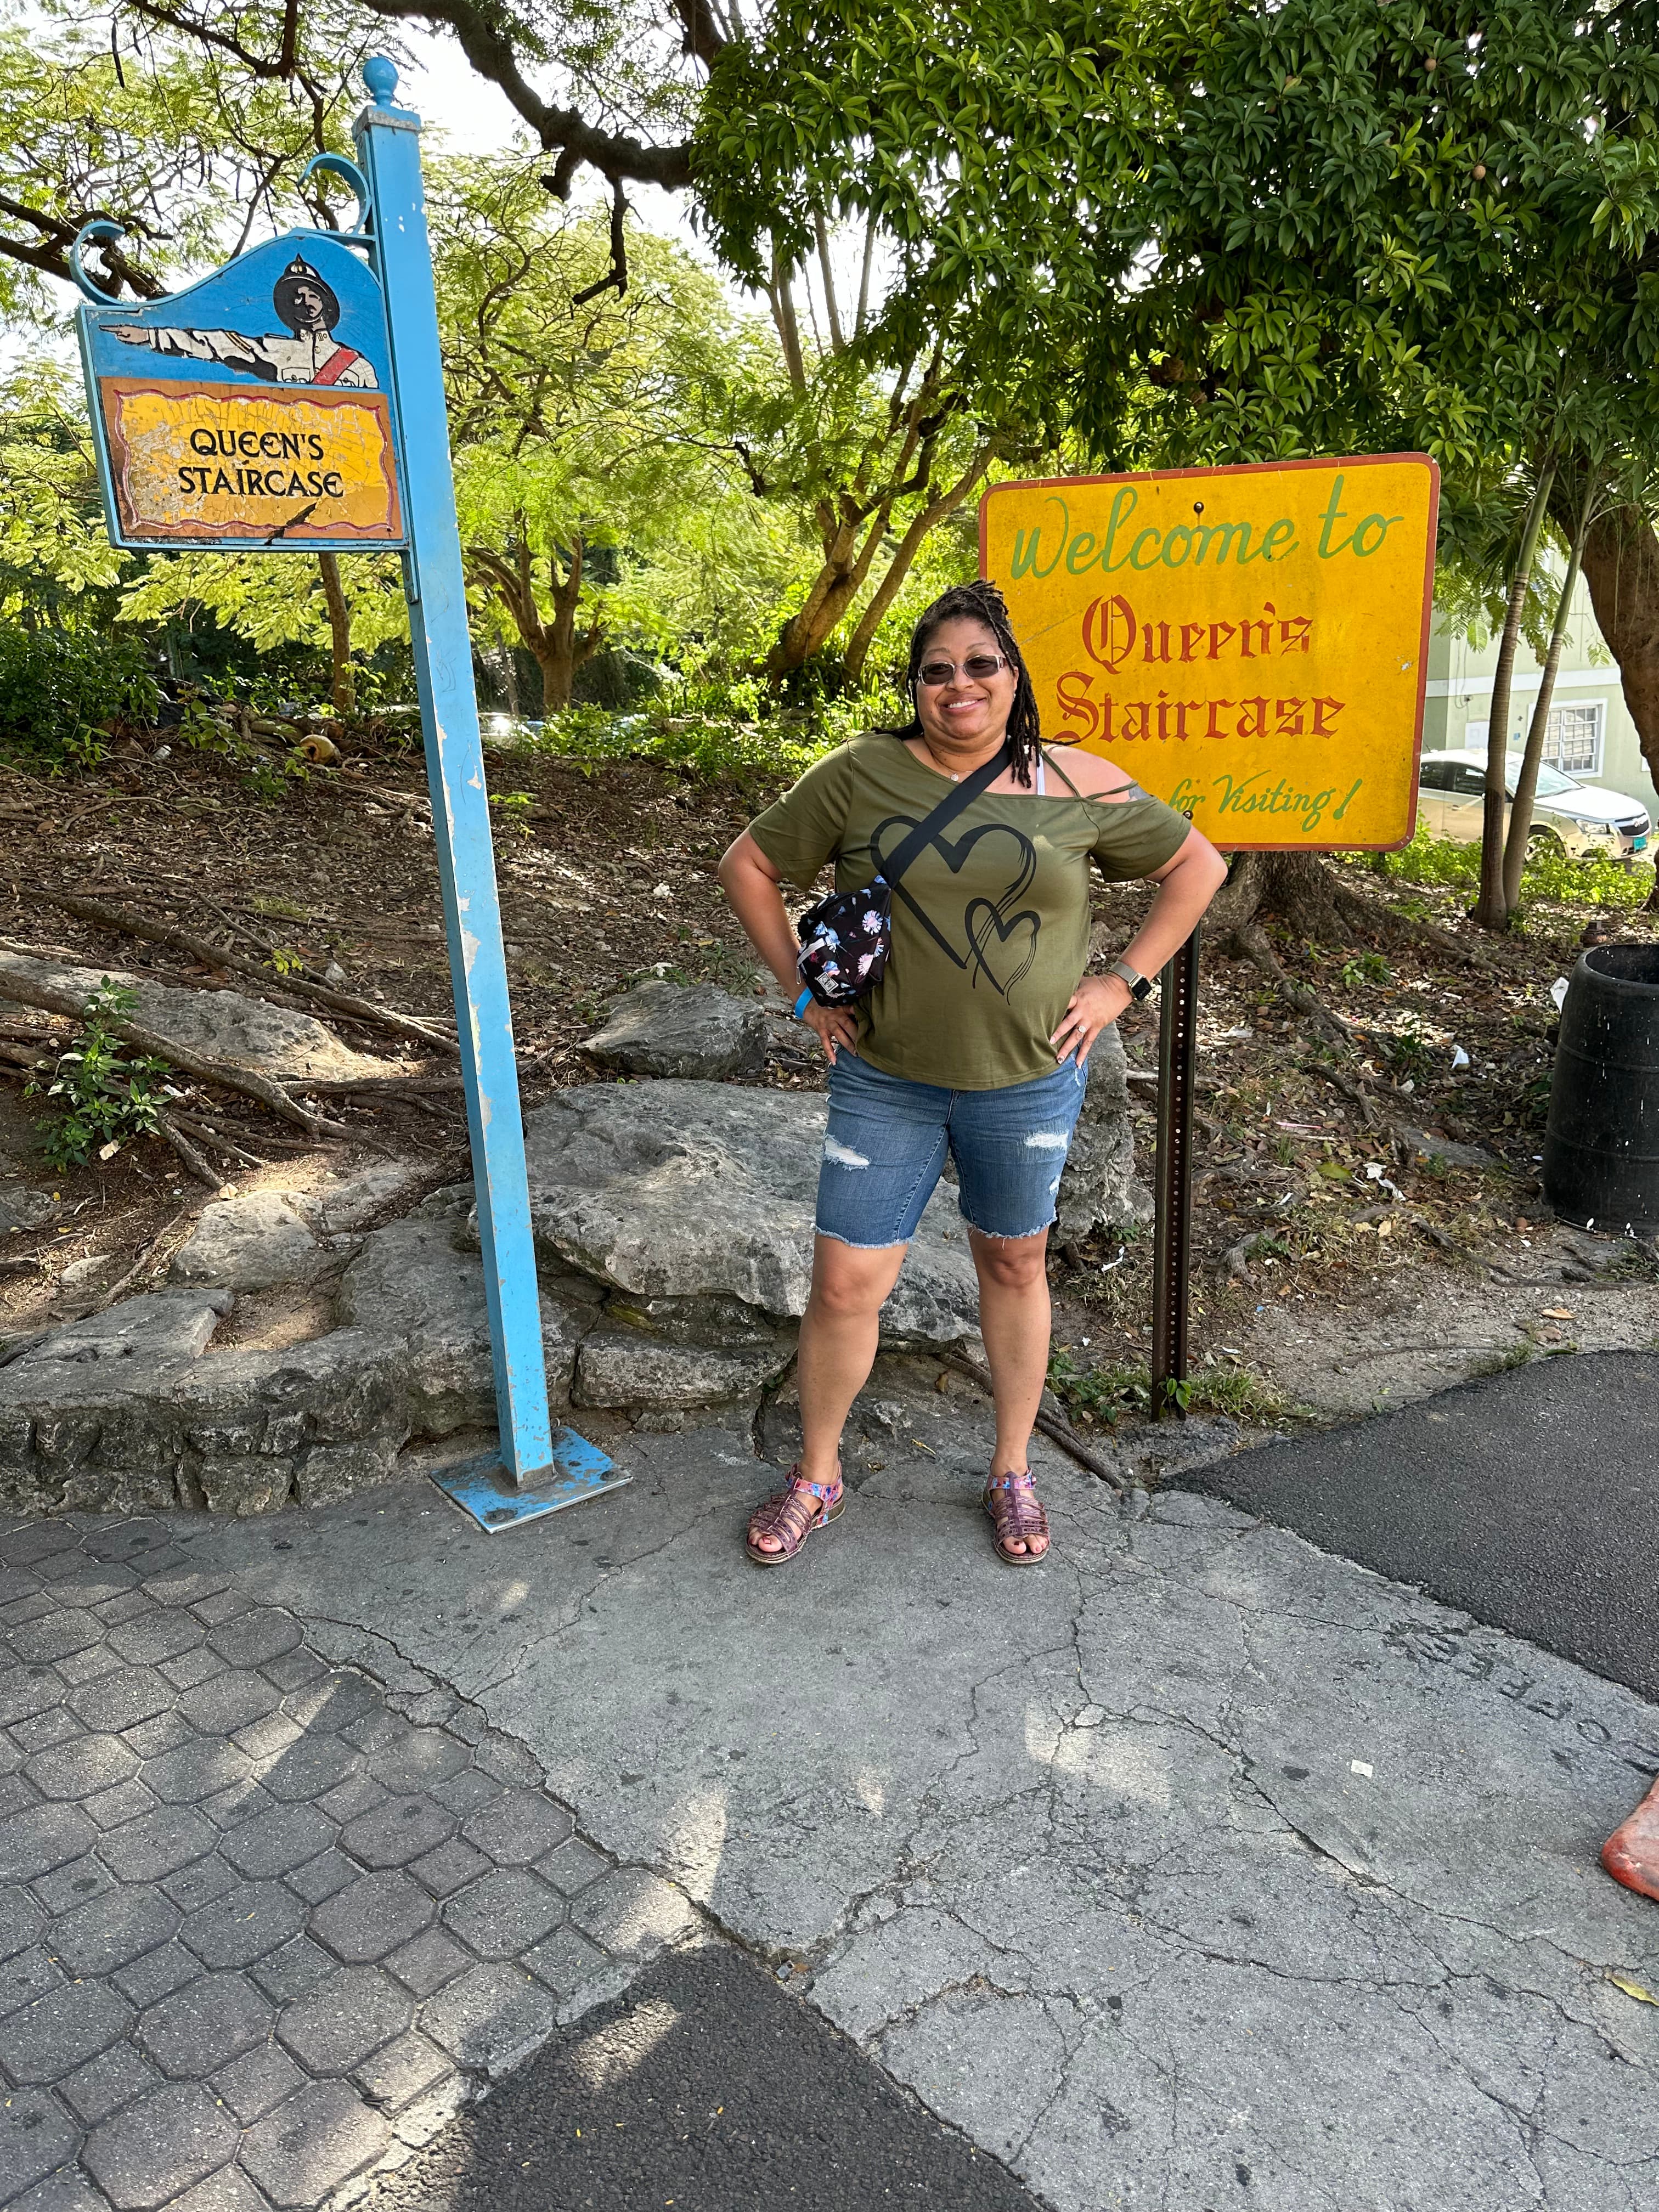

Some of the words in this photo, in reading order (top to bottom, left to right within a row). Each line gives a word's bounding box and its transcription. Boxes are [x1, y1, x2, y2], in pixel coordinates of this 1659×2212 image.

[190, 428, 324, 461] QUEEN'S
[178, 466, 344, 498] STAIRCASE
[1011, 486, 1300, 580] Welcome
[1318, 474, 1404, 560] to
[1082, 594, 1314, 675] Queen's
[1053, 671, 1346, 743] Staircase
[1169, 778, 1206, 813] for
